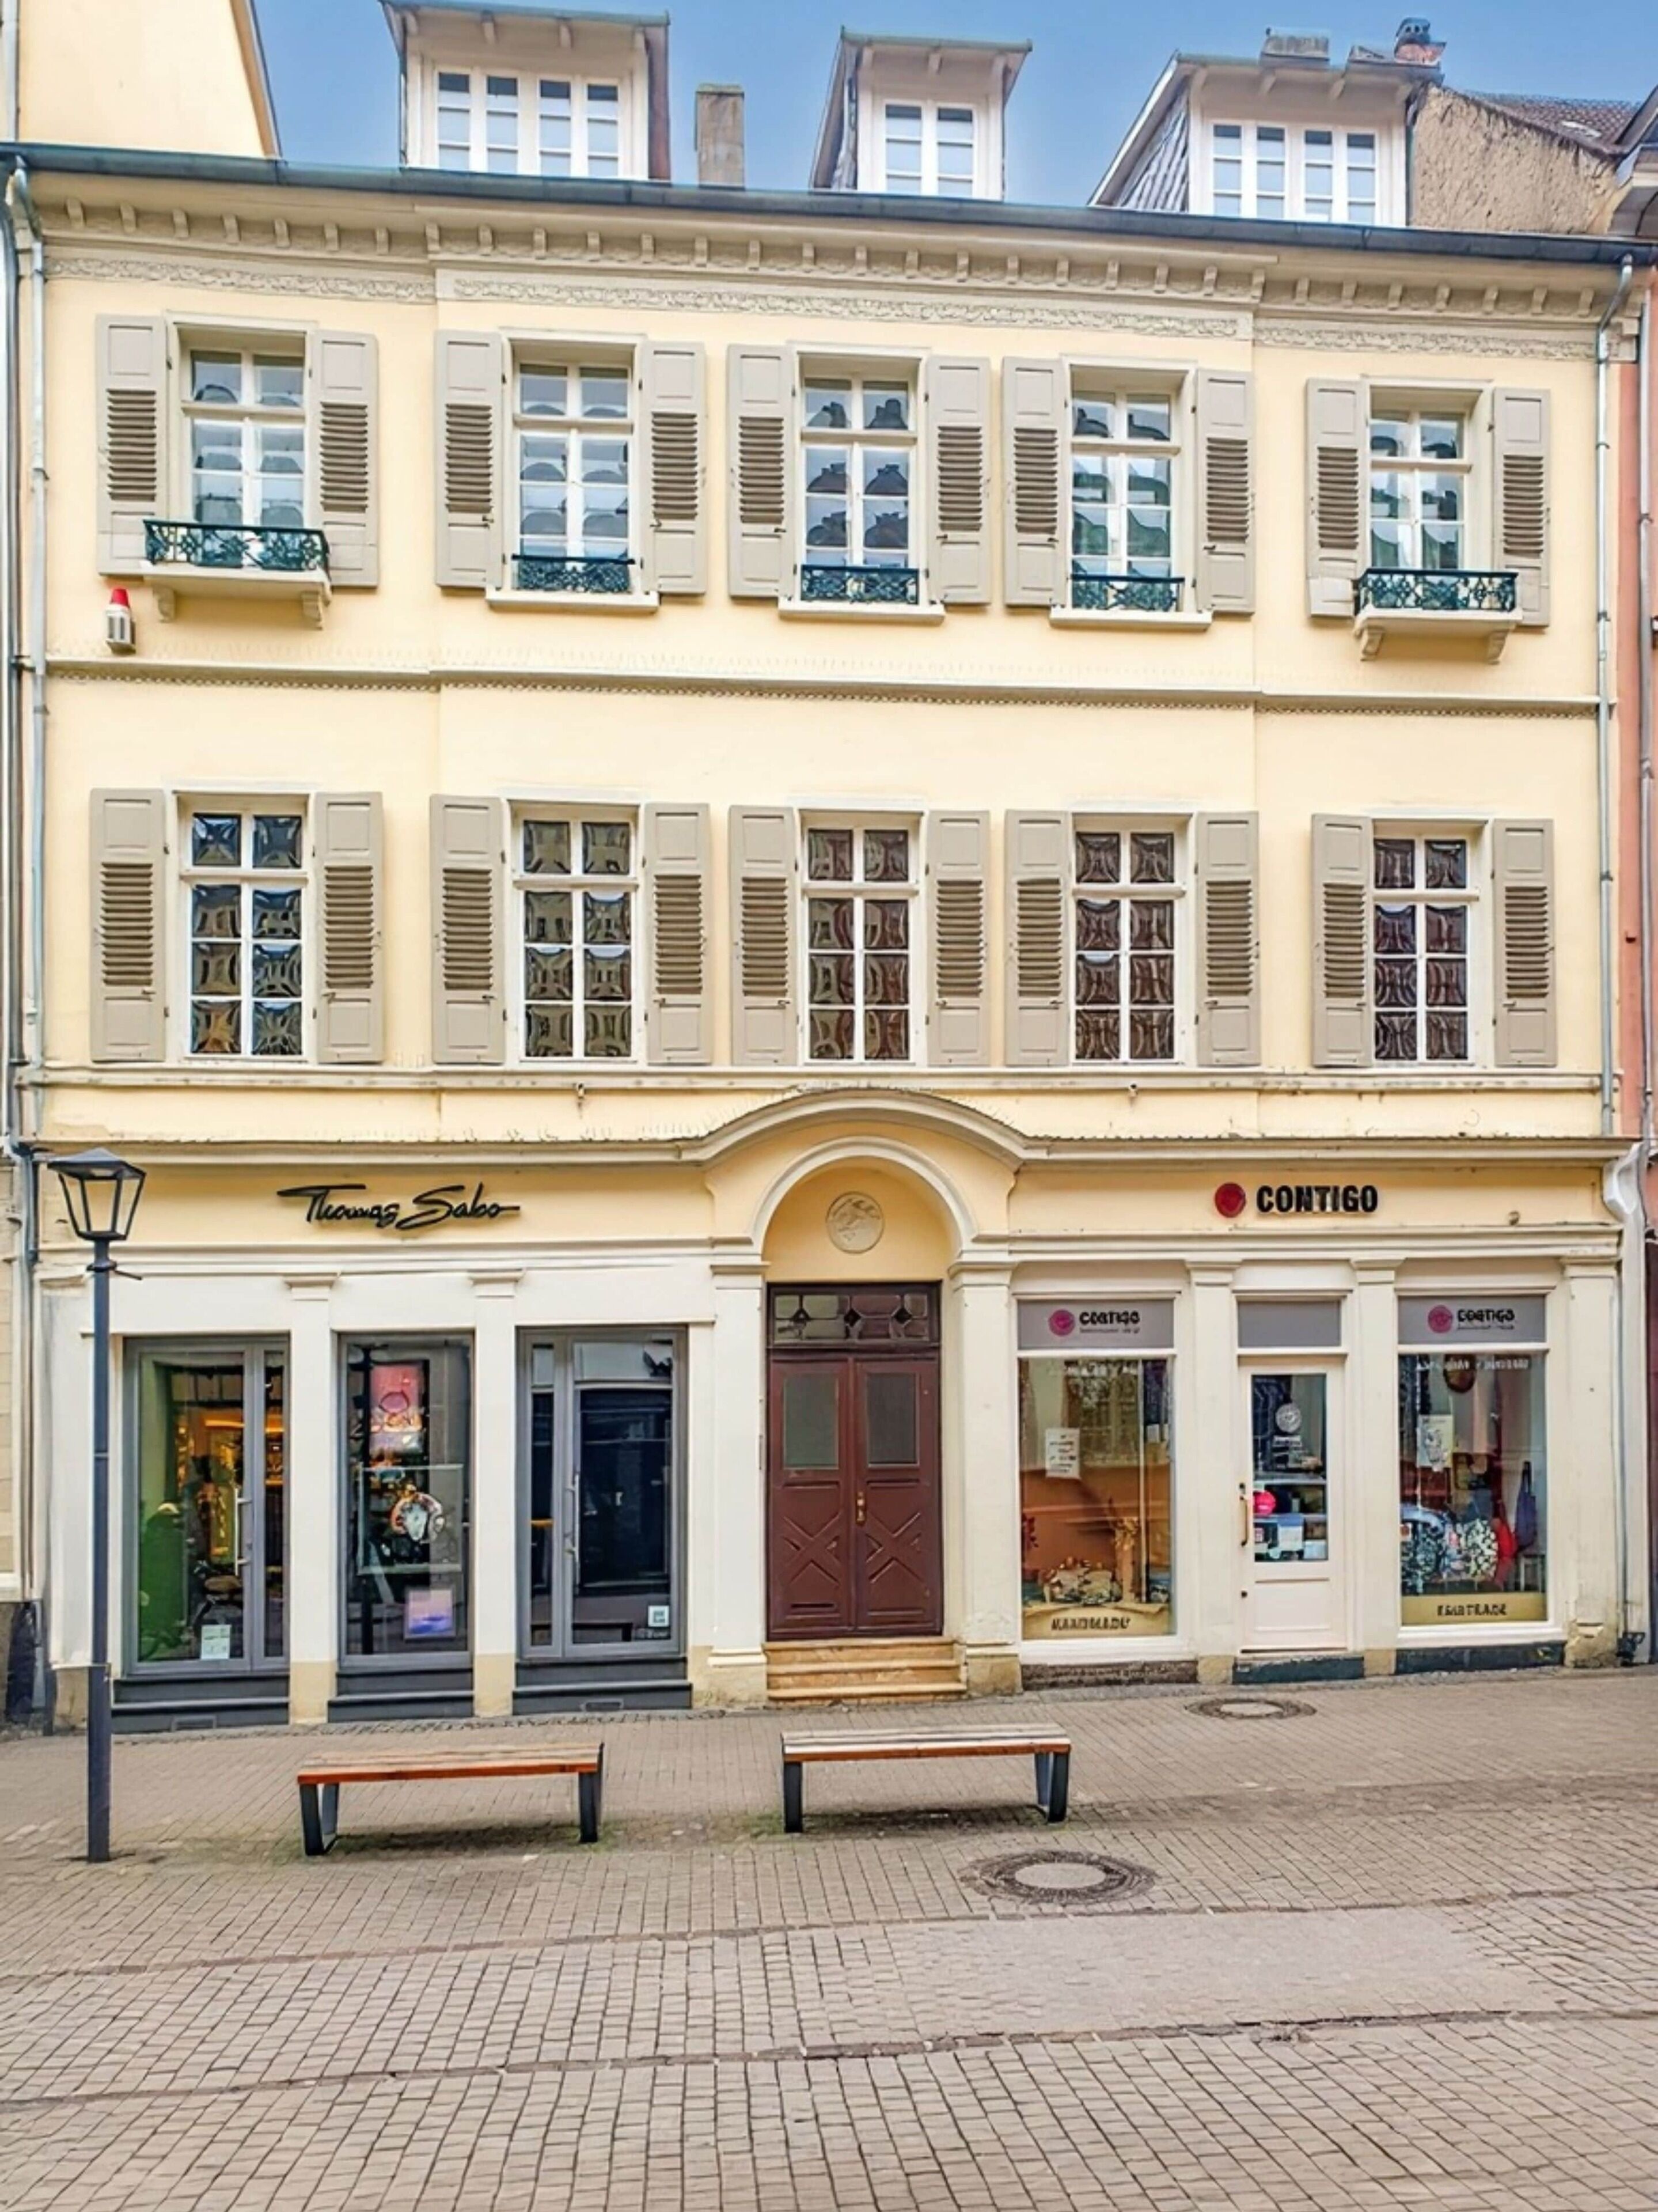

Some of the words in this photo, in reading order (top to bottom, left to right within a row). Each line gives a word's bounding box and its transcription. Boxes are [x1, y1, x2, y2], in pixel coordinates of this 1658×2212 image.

[276, 1184, 400, 1228] Thomas
[395, 1182, 521, 1230] Sabo
[1256, 1184, 1379, 1213] CONTIGO
